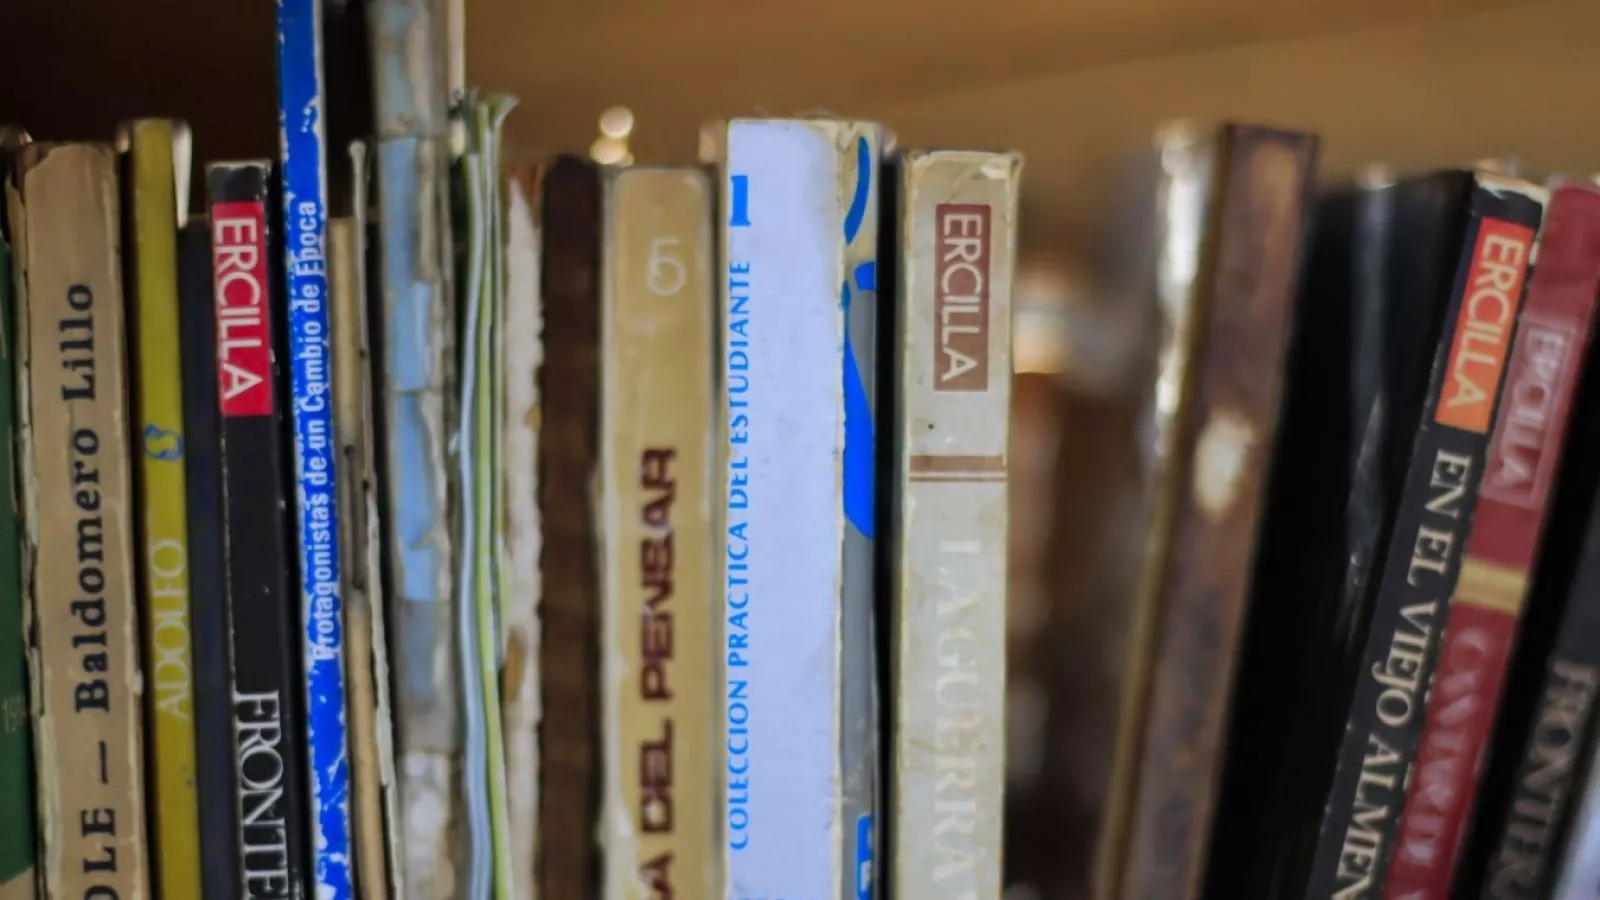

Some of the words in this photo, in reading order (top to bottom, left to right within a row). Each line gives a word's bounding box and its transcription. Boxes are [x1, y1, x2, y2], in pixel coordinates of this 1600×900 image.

[60, 284, 95, 401] Lillo
[214, 217, 264, 399] ERCILLA
[299, 284, 321, 313] de
[300, 321, 325, 412] Cambio
[729, 260, 751, 444] ESTUDIANTE
[941, 213, 984, 381] ERCILLA
[1447, 234, 1525, 408] ERCILLA
[303, 457, 327, 486] de
[304, 419, 326, 448] un
[728, 457, 749, 509] DEL
[1425, 450, 1473, 518] EN
[71, 428, 110, 712] Baldomero
[307, 493, 340, 661] Protagonistas
[640, 447, 677, 700] PENSAR
[727, 522, 749, 667] PRACTICA
[1407, 526, 1453, 587] EL
[150, 538, 190, 722] ADOLFO
[1372, 601, 1436, 727] VIEJO
[232, 690, 289, 900] FRONTE
[640, 718, 674, 834] DEL
[727, 679, 749, 850] COLECCION
